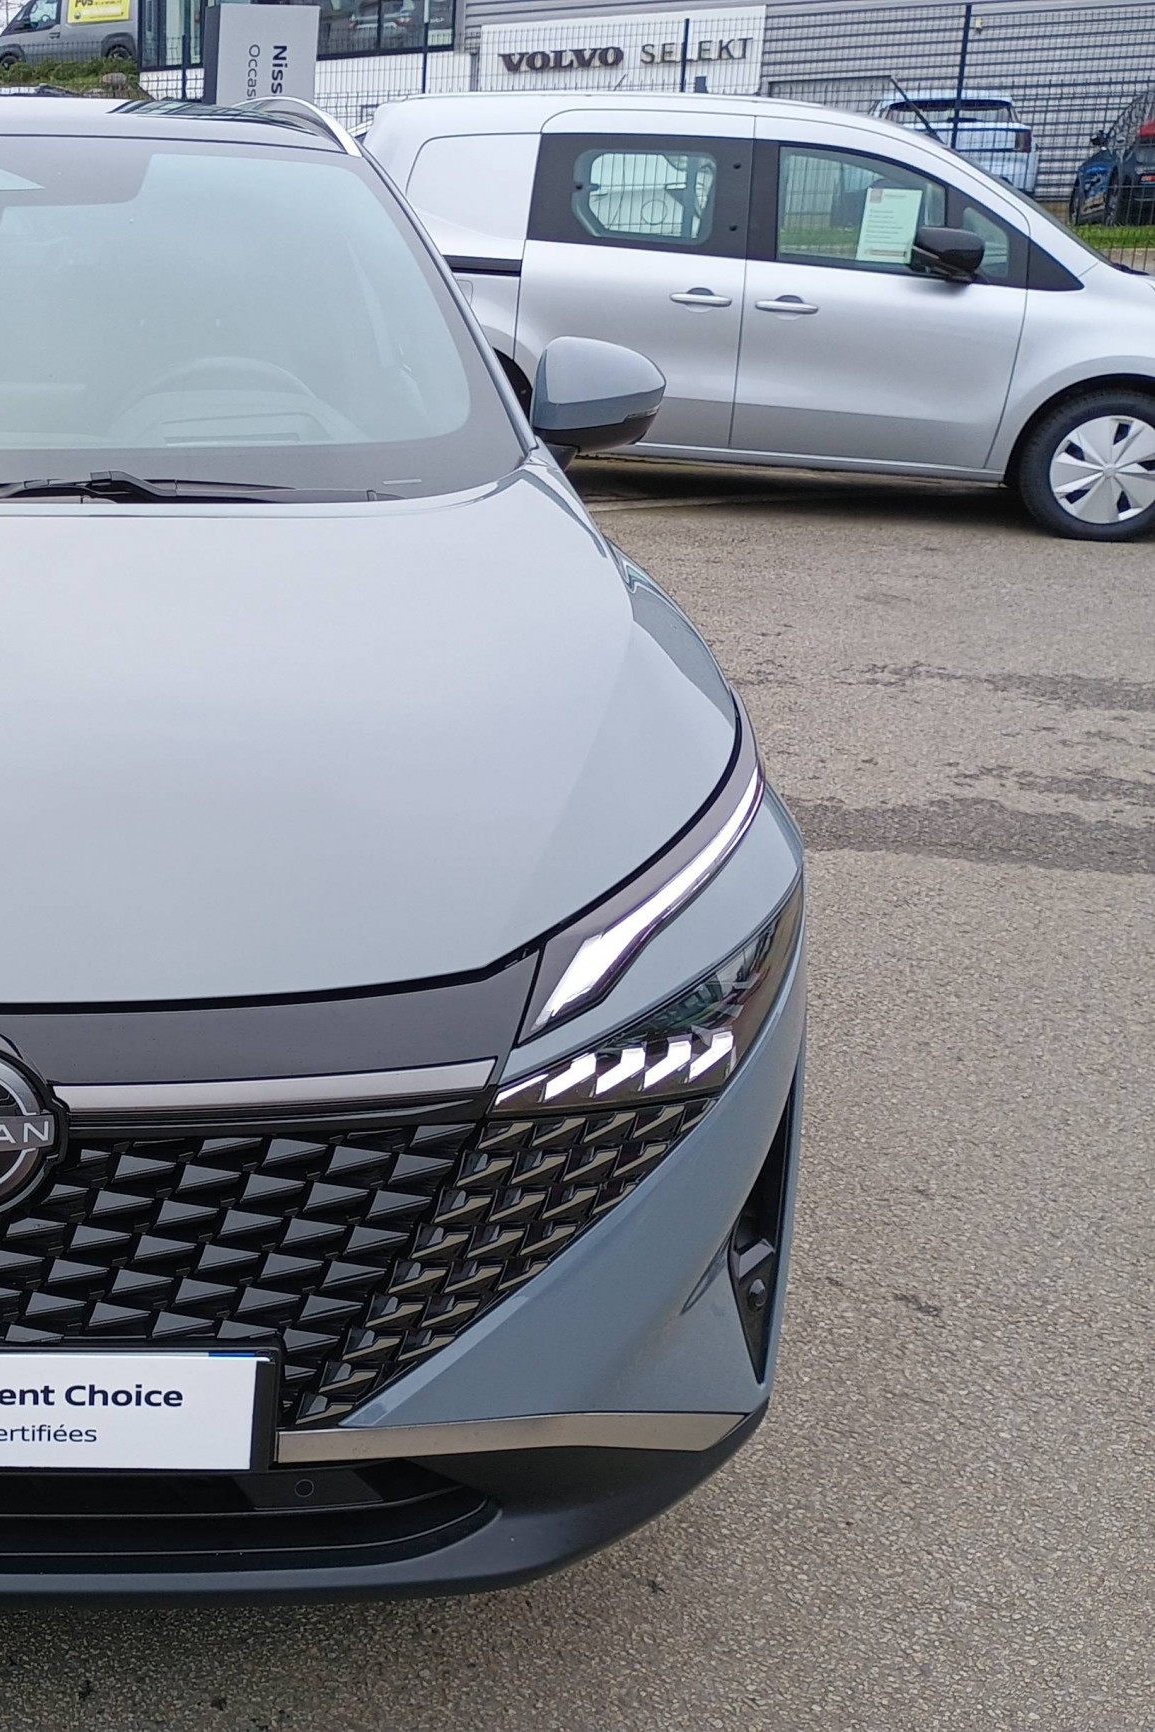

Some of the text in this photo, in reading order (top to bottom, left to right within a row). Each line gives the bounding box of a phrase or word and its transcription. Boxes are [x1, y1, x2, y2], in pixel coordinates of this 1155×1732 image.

[246, 44, 260, 98] Occas
[271, 45, 288, 95] Niss
[498, 46, 624, 73] VOLVO
[64, 1384, 183, 1408] Choice
